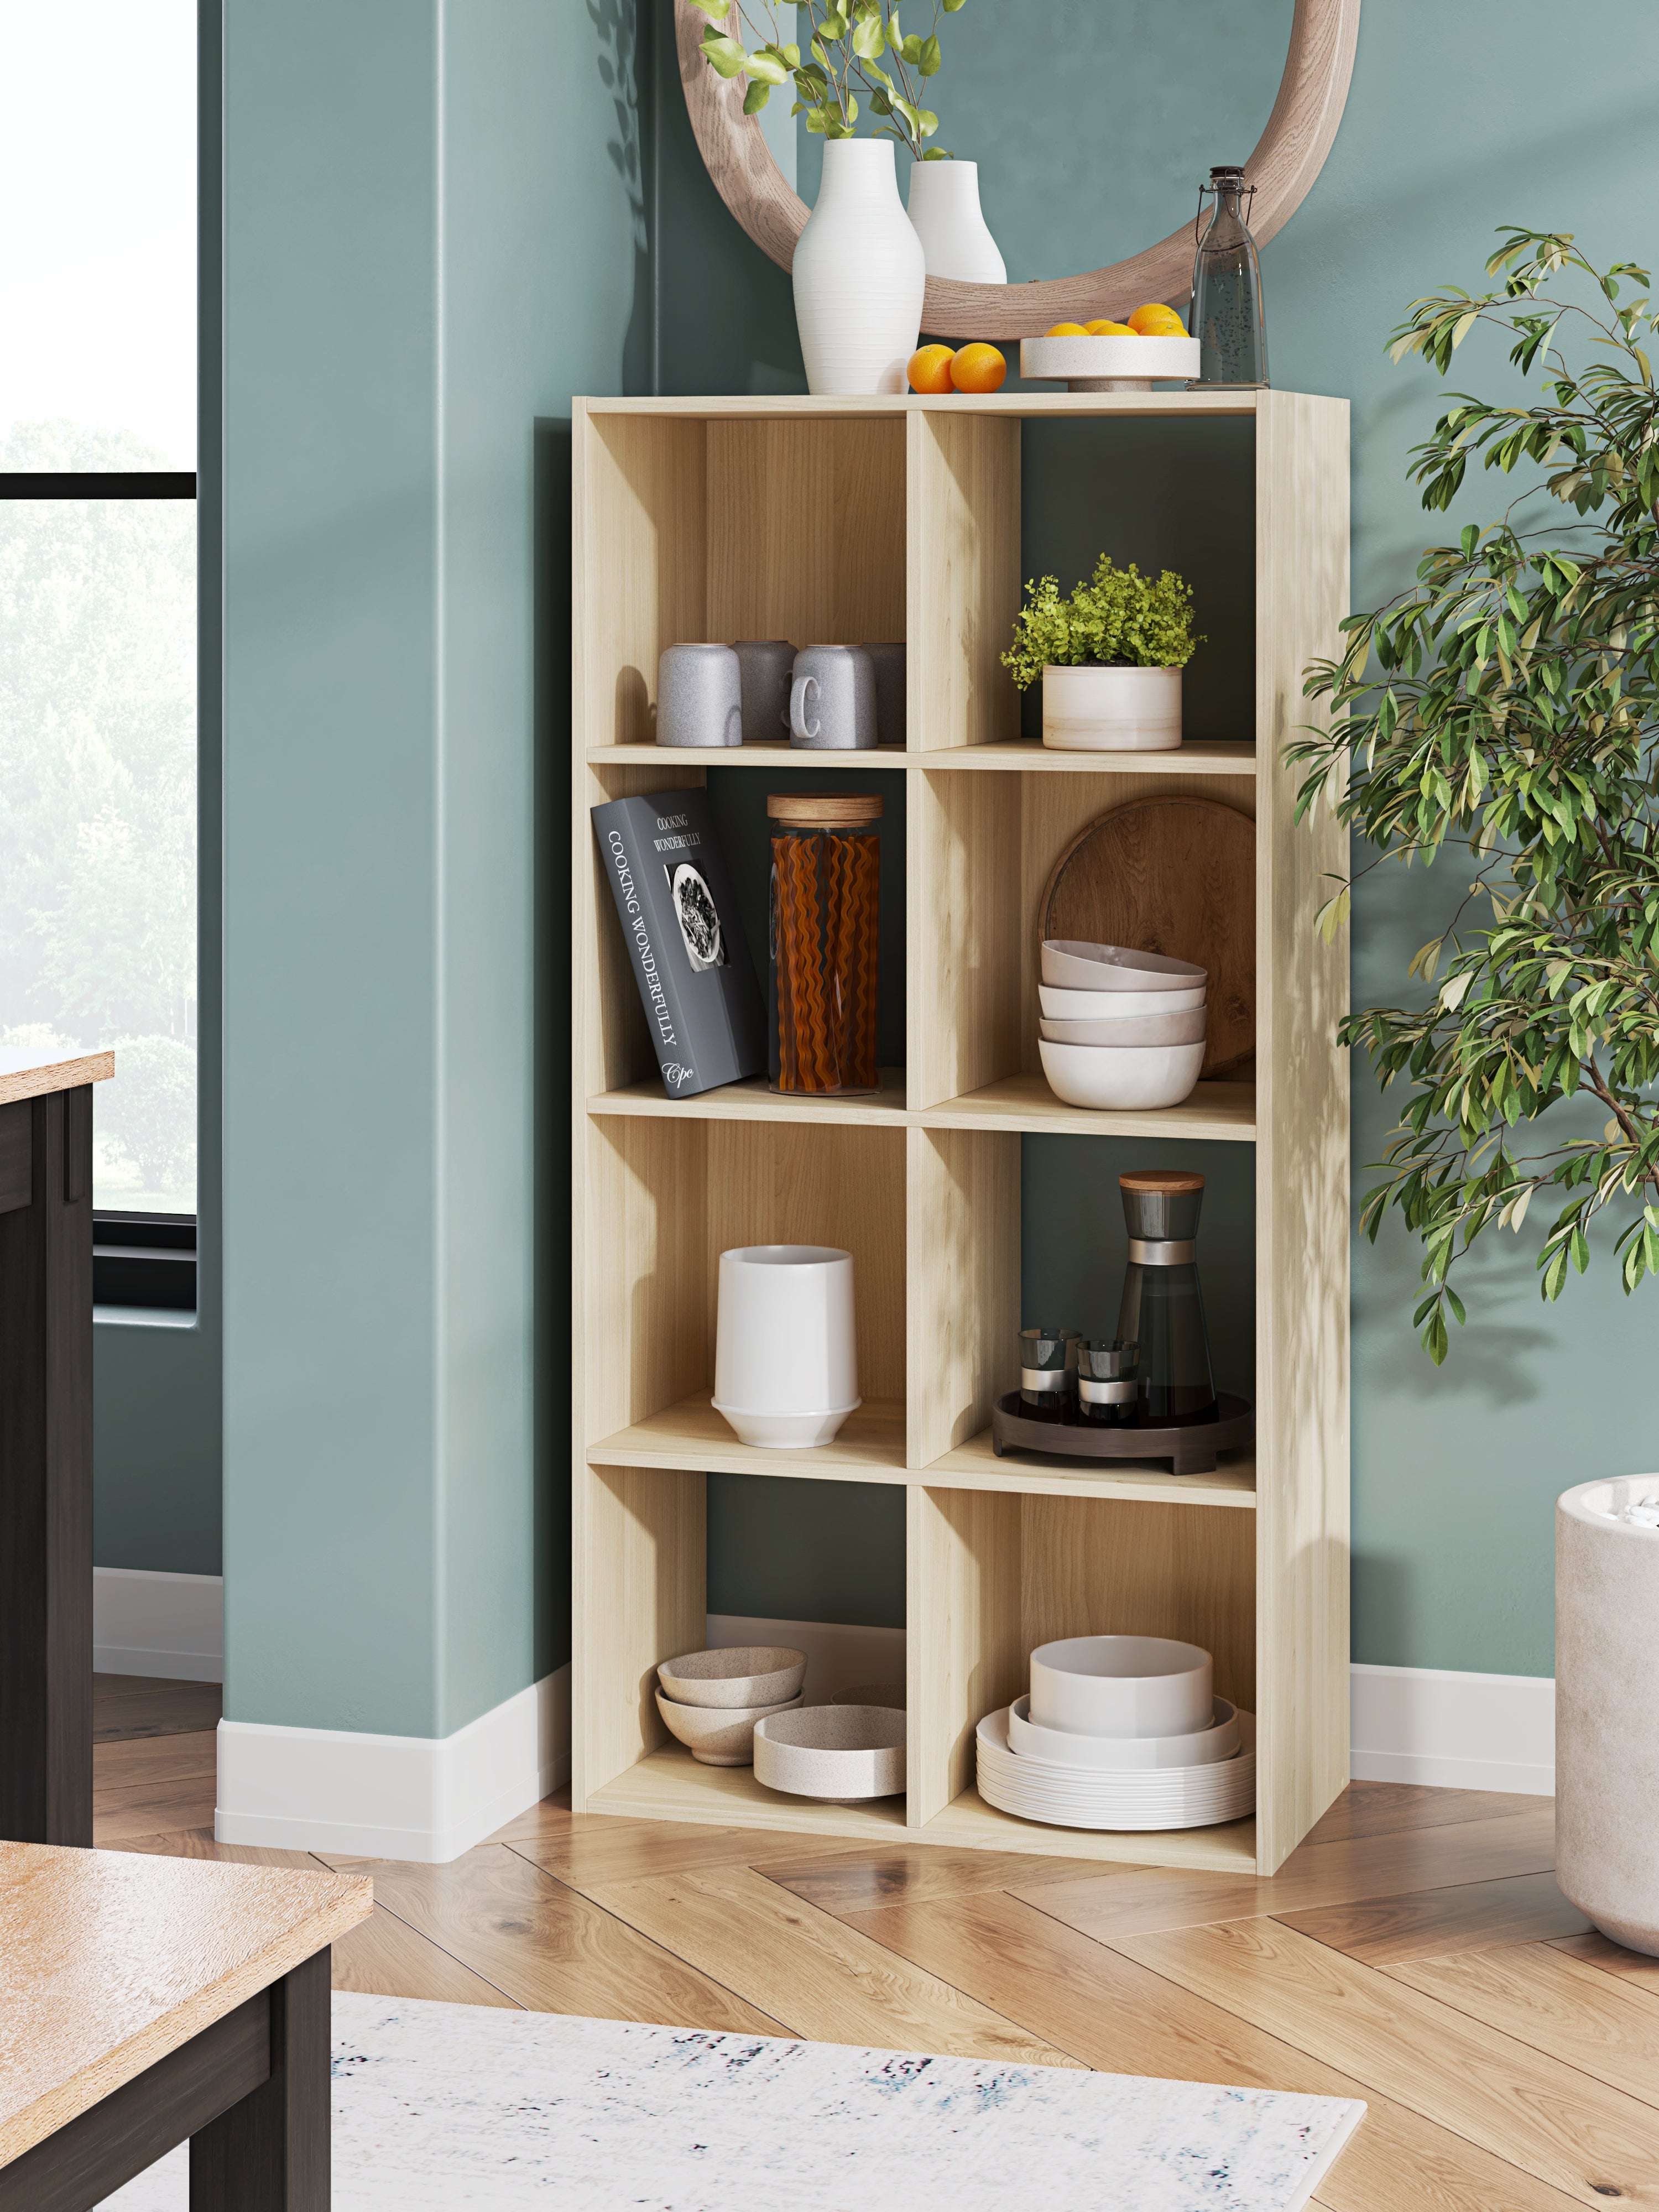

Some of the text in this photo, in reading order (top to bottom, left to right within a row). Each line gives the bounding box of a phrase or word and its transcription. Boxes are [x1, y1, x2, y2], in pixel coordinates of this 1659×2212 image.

[657, 814, 688, 830] COOKING
[654, 832, 701, 852] WONDERFULLY
[609, 831, 677, 1045] COOKING WONDERFULLY
